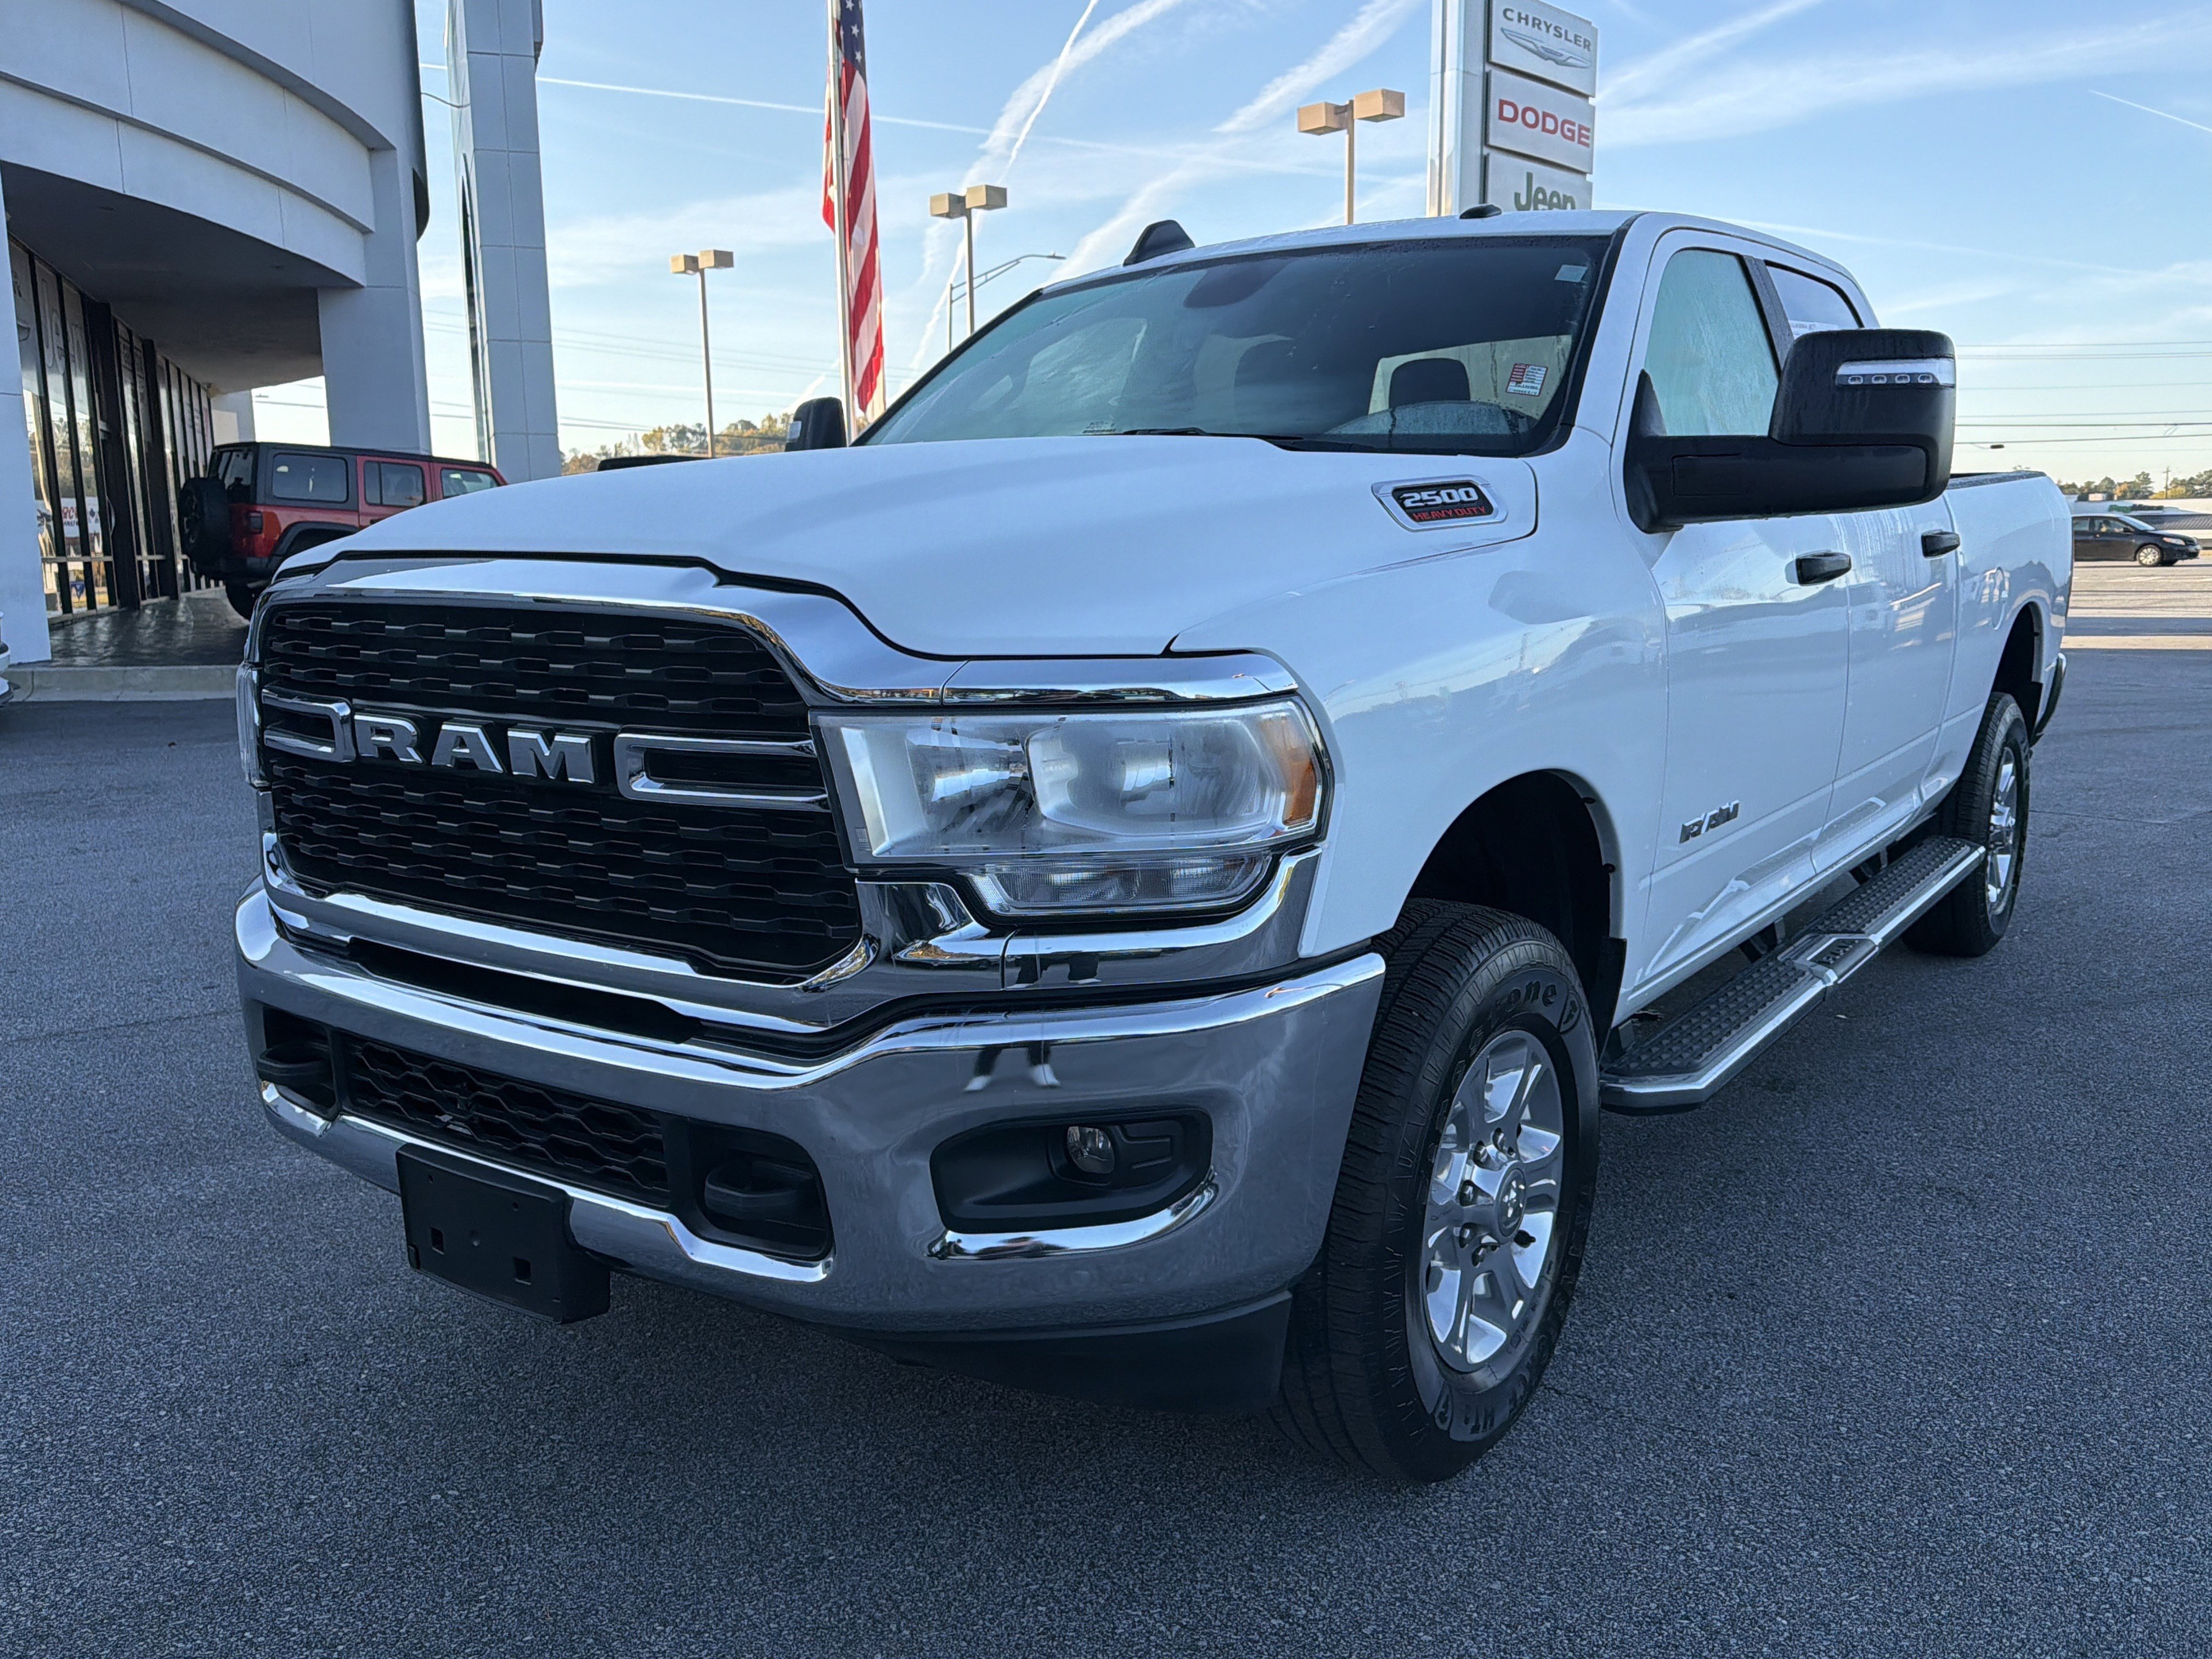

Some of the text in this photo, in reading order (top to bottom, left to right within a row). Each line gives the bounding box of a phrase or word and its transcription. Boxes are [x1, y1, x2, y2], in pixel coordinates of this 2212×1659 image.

[1502, 8, 1591, 52] CHRYSLER
[1498, 99, 1590, 148] DODGE
[1402, 487, 1479, 507] 2500
[1412, 506, 1486, 520] HEAVY DUTY
[354, 713, 597, 783] RAM
[1679, 799, 1739, 844] RAM
